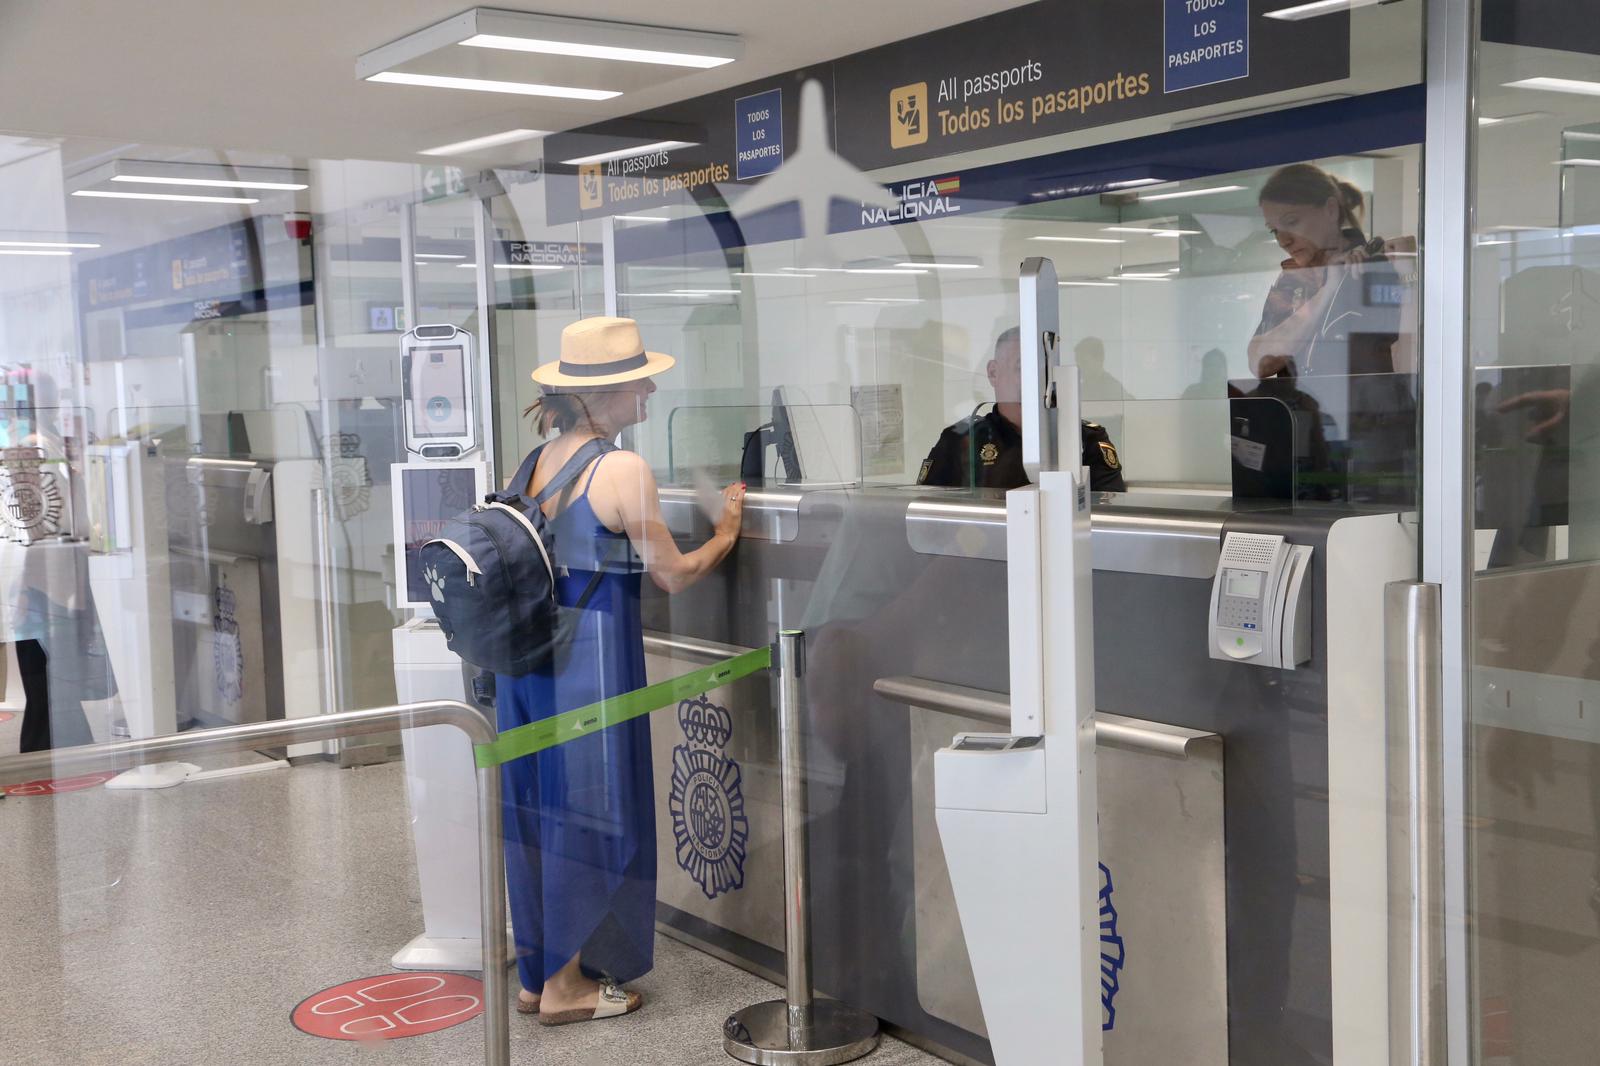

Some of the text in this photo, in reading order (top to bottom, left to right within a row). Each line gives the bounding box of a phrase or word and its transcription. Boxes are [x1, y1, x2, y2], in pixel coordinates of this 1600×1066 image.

[1194, 20, 1217, 37] LOS
[1168, 39, 1243, 68] PASAPORTES
[938, 59, 1042, 103] All passports
[747, 109, 770, 124] TODOS
[938, 72, 1150, 136] Todos los pasaportes
[752, 128, 766, 141] LOS
[607, 149, 669, 177] All passports
[738, 144, 781, 162] PASAPORTES
[608, 162, 729, 202] Todos los pasaportes
[861, 196, 961, 226] NACIONAL
[511, 253, 588, 264] NACIONAL
